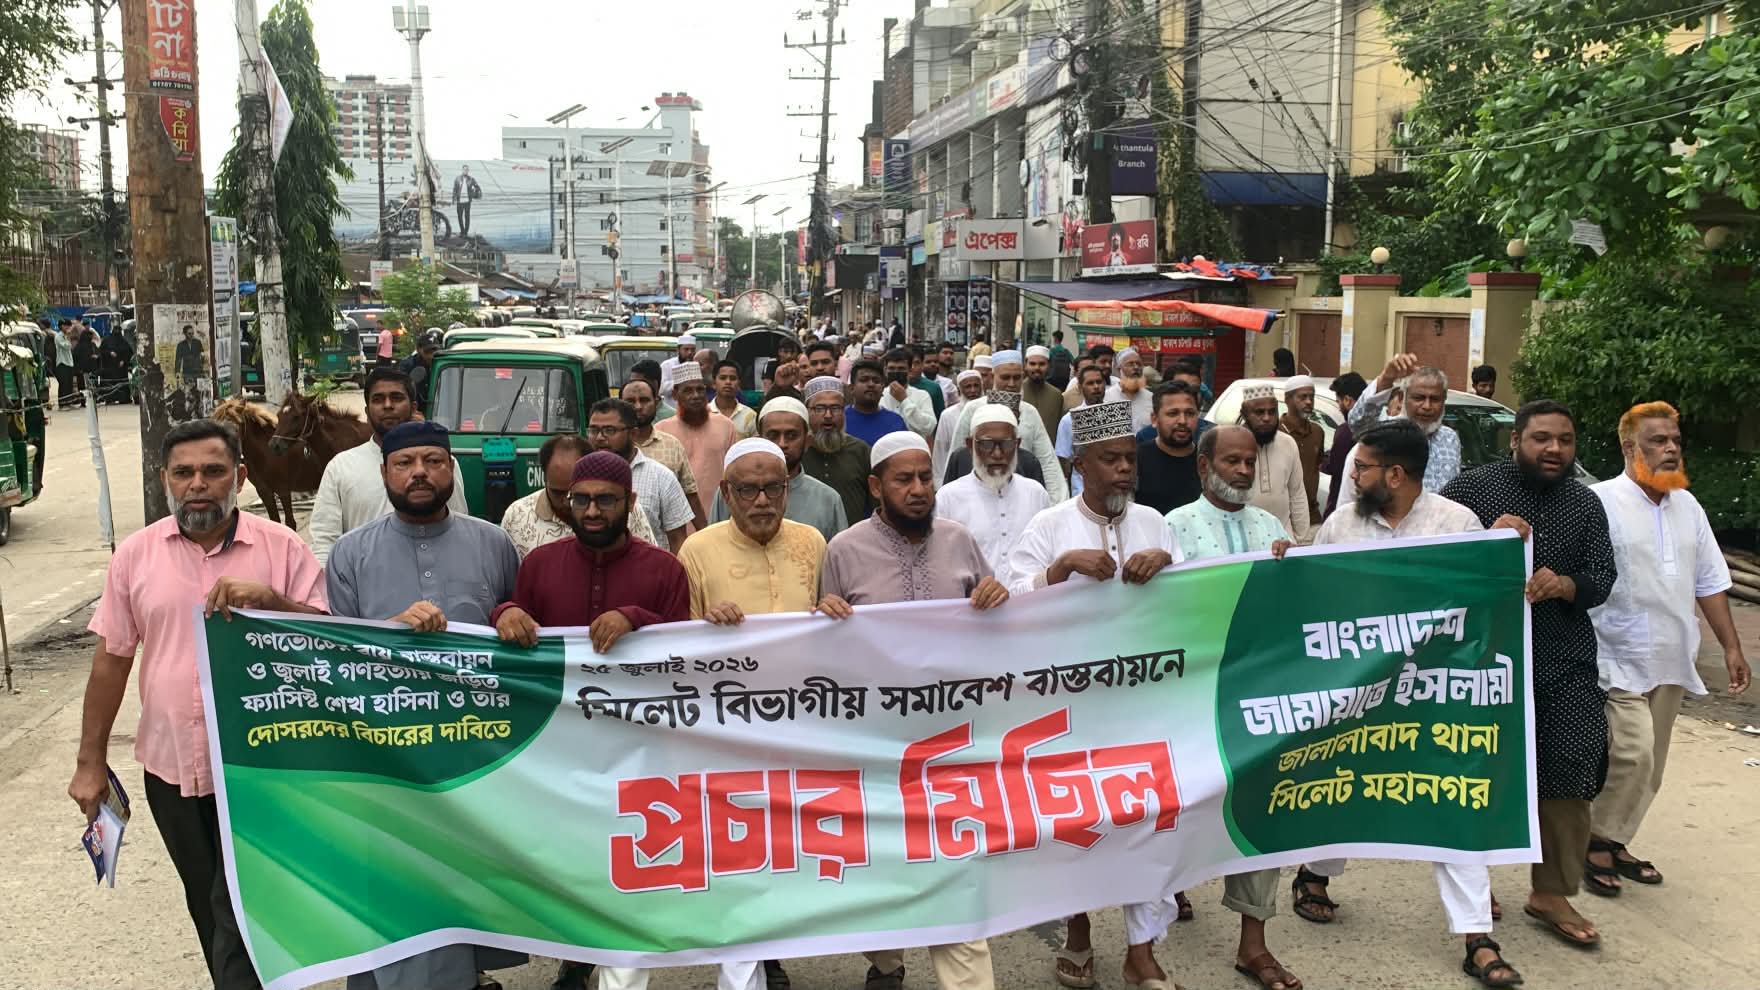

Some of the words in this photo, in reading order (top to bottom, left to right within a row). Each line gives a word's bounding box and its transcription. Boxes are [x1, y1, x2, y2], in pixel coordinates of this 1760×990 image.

[1117, 160, 1146, 168] Branch
[964, 230, 1018, 251] এপেক্স
[1302, 607, 1468, 660] বাংলাদেশ
[246, 662, 267, 680] ও
[271, 656, 334, 686] জুলাই
[618, 653, 687, 677] জুলাই
[693, 656, 760, 674] ২০২৬
[240, 686, 320, 713] ফ্যাসিস্ট
[324, 695, 365, 715] শেখ
[372, 685, 440, 715] হাসিনা
[446, 691, 466, 709] ও
[470, 689, 511, 709] তার
[575, 680, 702, 729] সিলেট
[709, 675, 868, 726] বিভাগীয়
[878, 671, 1016, 718] সমাবেশ
[1022, 647, 1187, 697] বাস্তবায়নে
[1239, 675, 1392, 736] জামায়াতে
[1394, 653, 1514, 708] ইসলামী
[247, 718, 350, 748] দোসরদের
[352, 719, 433, 747] বিচারের
[439, 714, 512, 743] দাবিতে
[1278, 721, 1421, 773] জালালাবাদ
[1431, 721, 1500, 755] থানা
[608, 766, 872, 894] প্রচার
[898, 705, 1186, 864] মিছিল
[1267, 766, 1356, 815] সিলেট
[1361, 771, 1491, 809] মহানগর
